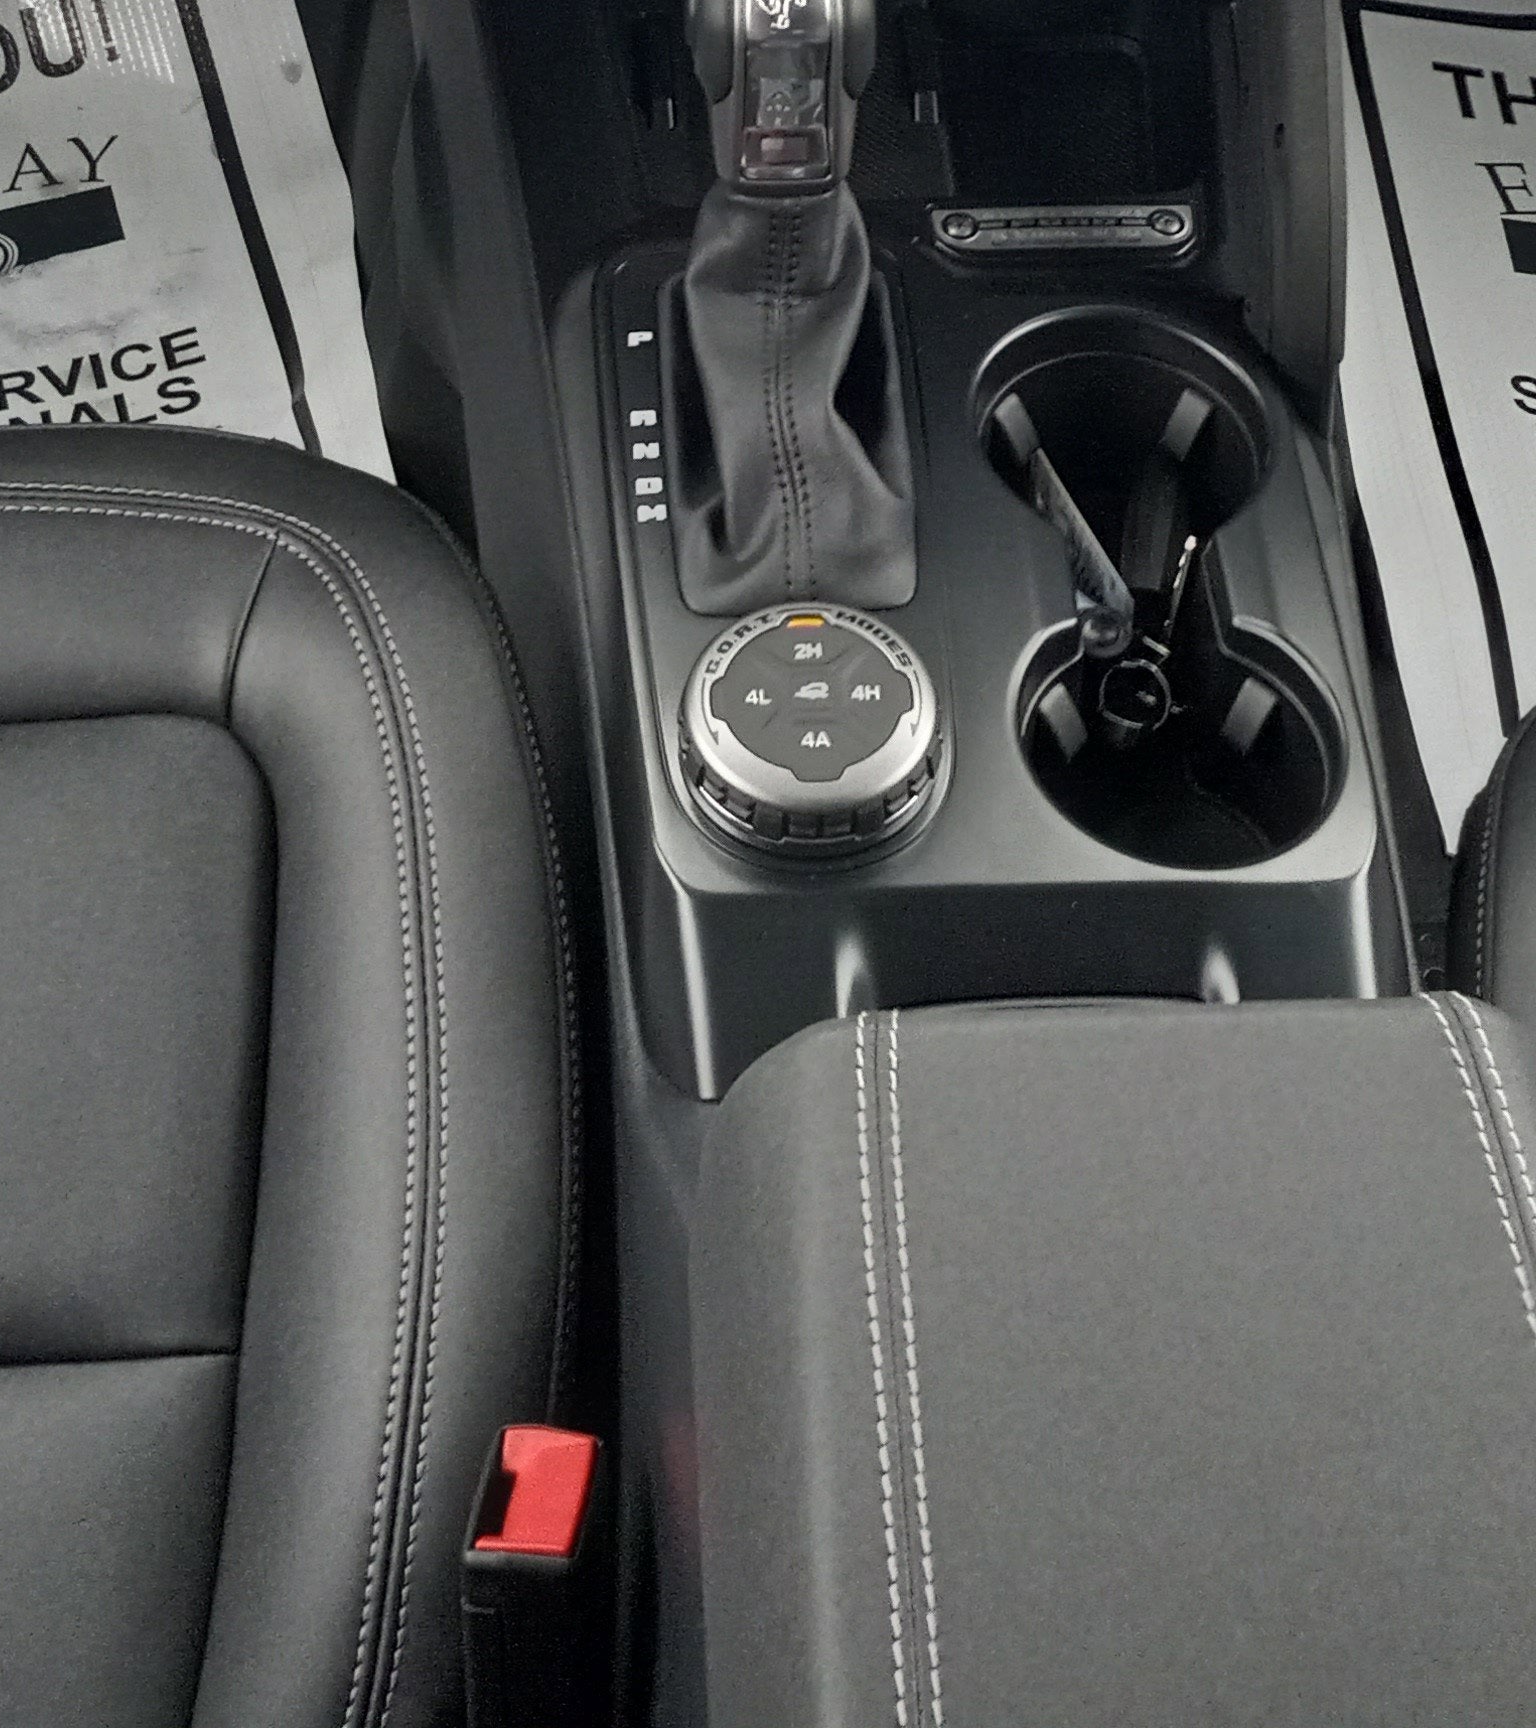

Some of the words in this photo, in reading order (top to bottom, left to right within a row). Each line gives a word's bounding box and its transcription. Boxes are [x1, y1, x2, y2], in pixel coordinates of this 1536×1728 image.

[626, 330, 654, 348] P
[834, 609, 914, 669] MODES
[793, 642, 823, 660] 2H
[744, 688, 773, 705] 4L
[850, 684, 882, 702] 4H
[800, 730, 832, 748] 4A
